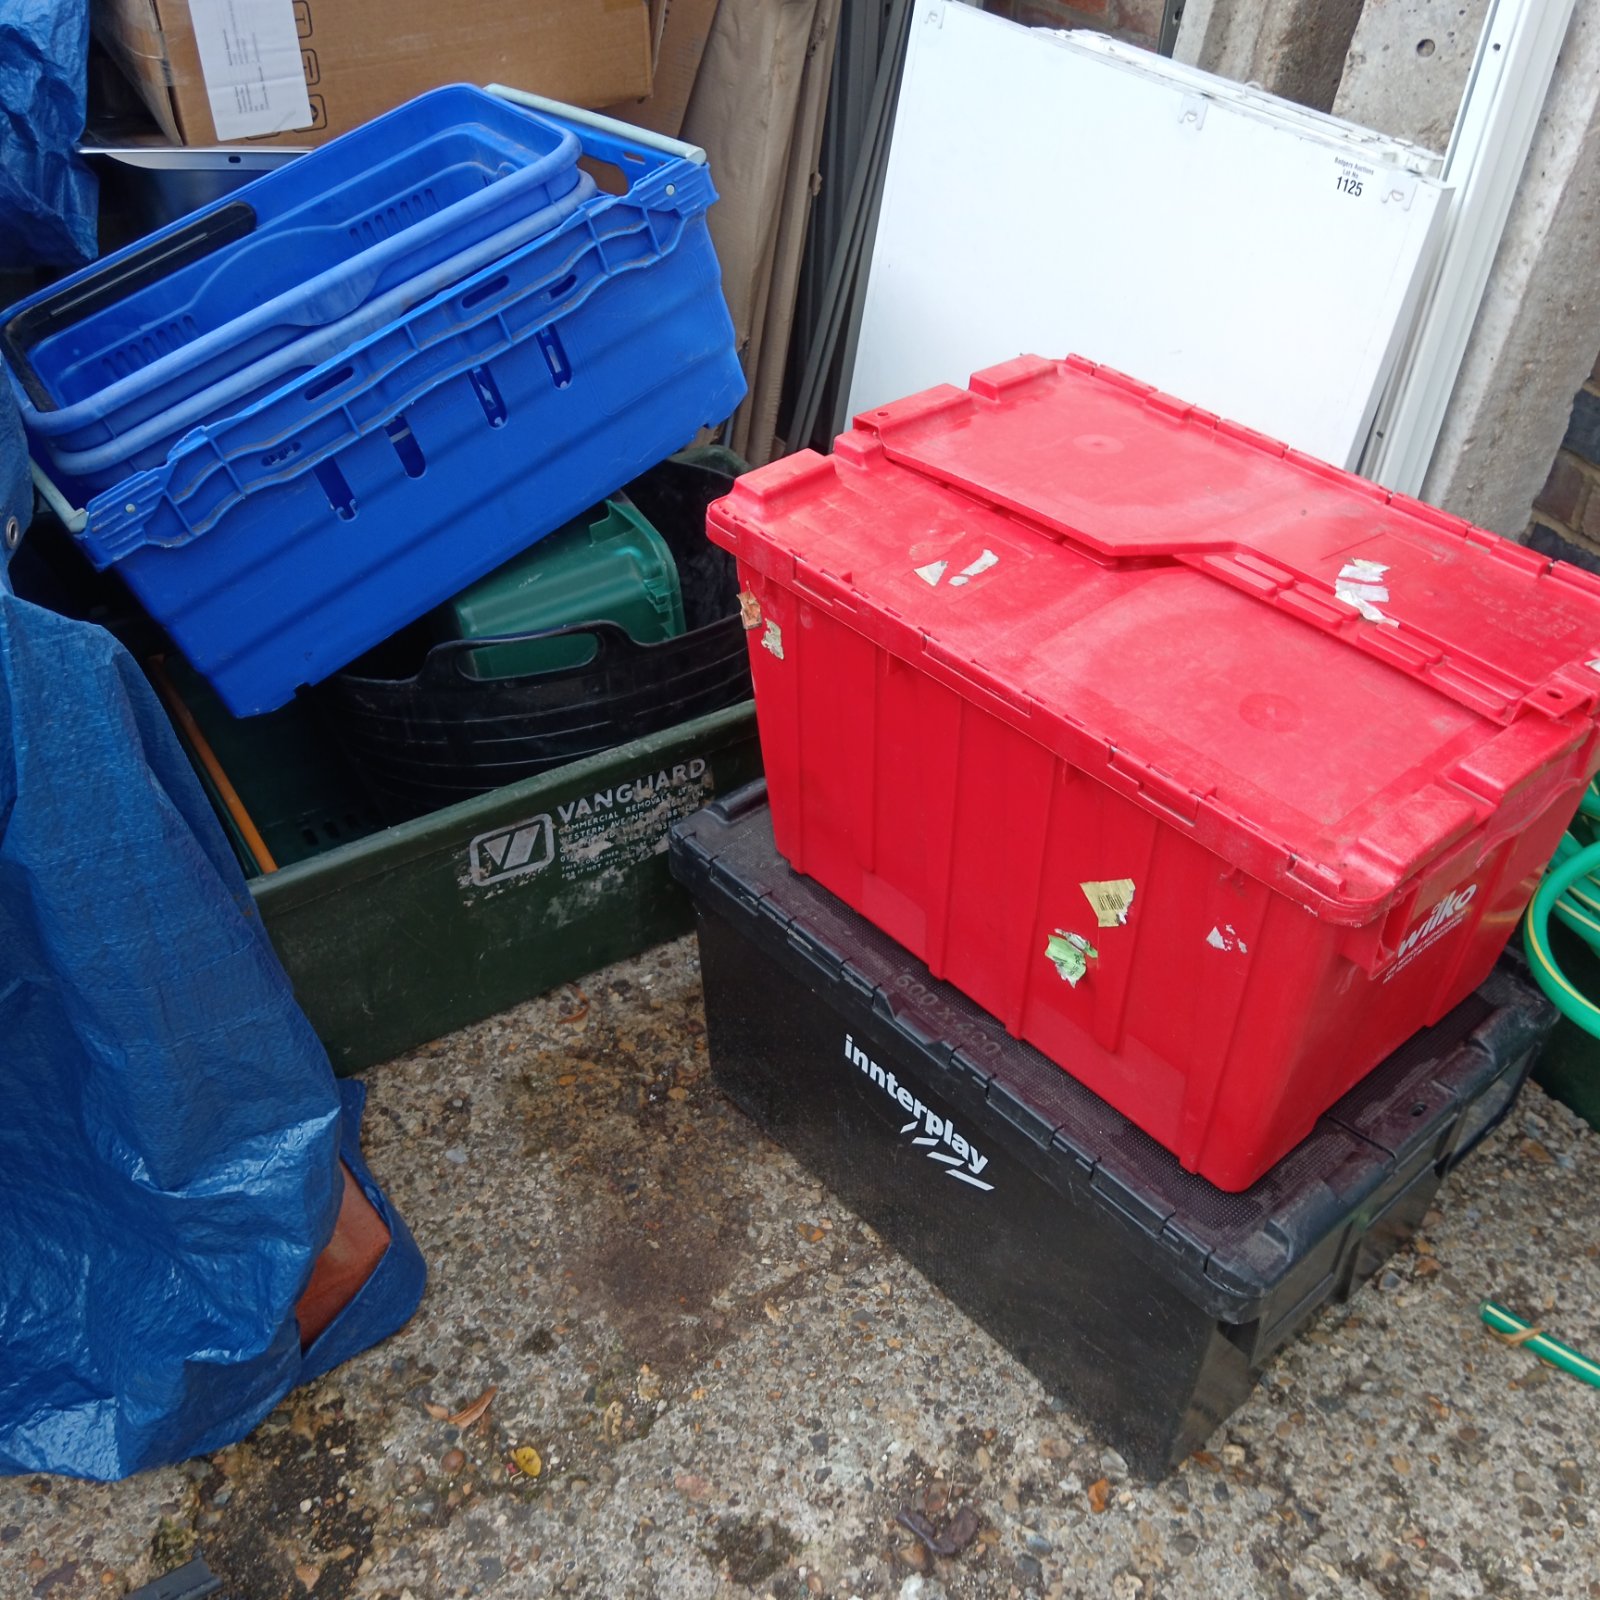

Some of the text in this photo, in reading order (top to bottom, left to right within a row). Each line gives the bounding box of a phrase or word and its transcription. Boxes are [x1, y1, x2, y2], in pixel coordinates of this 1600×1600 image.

[1337, 176, 1363, 197] 1125
[557, 759, 705, 824] VANGUARD
[558, 811, 618, 836] COMMERCIAL
[1398, 884, 1477, 958] wilko
[896, 974, 939, 1006] 600
[844, 1033, 988, 1175] innterplay
